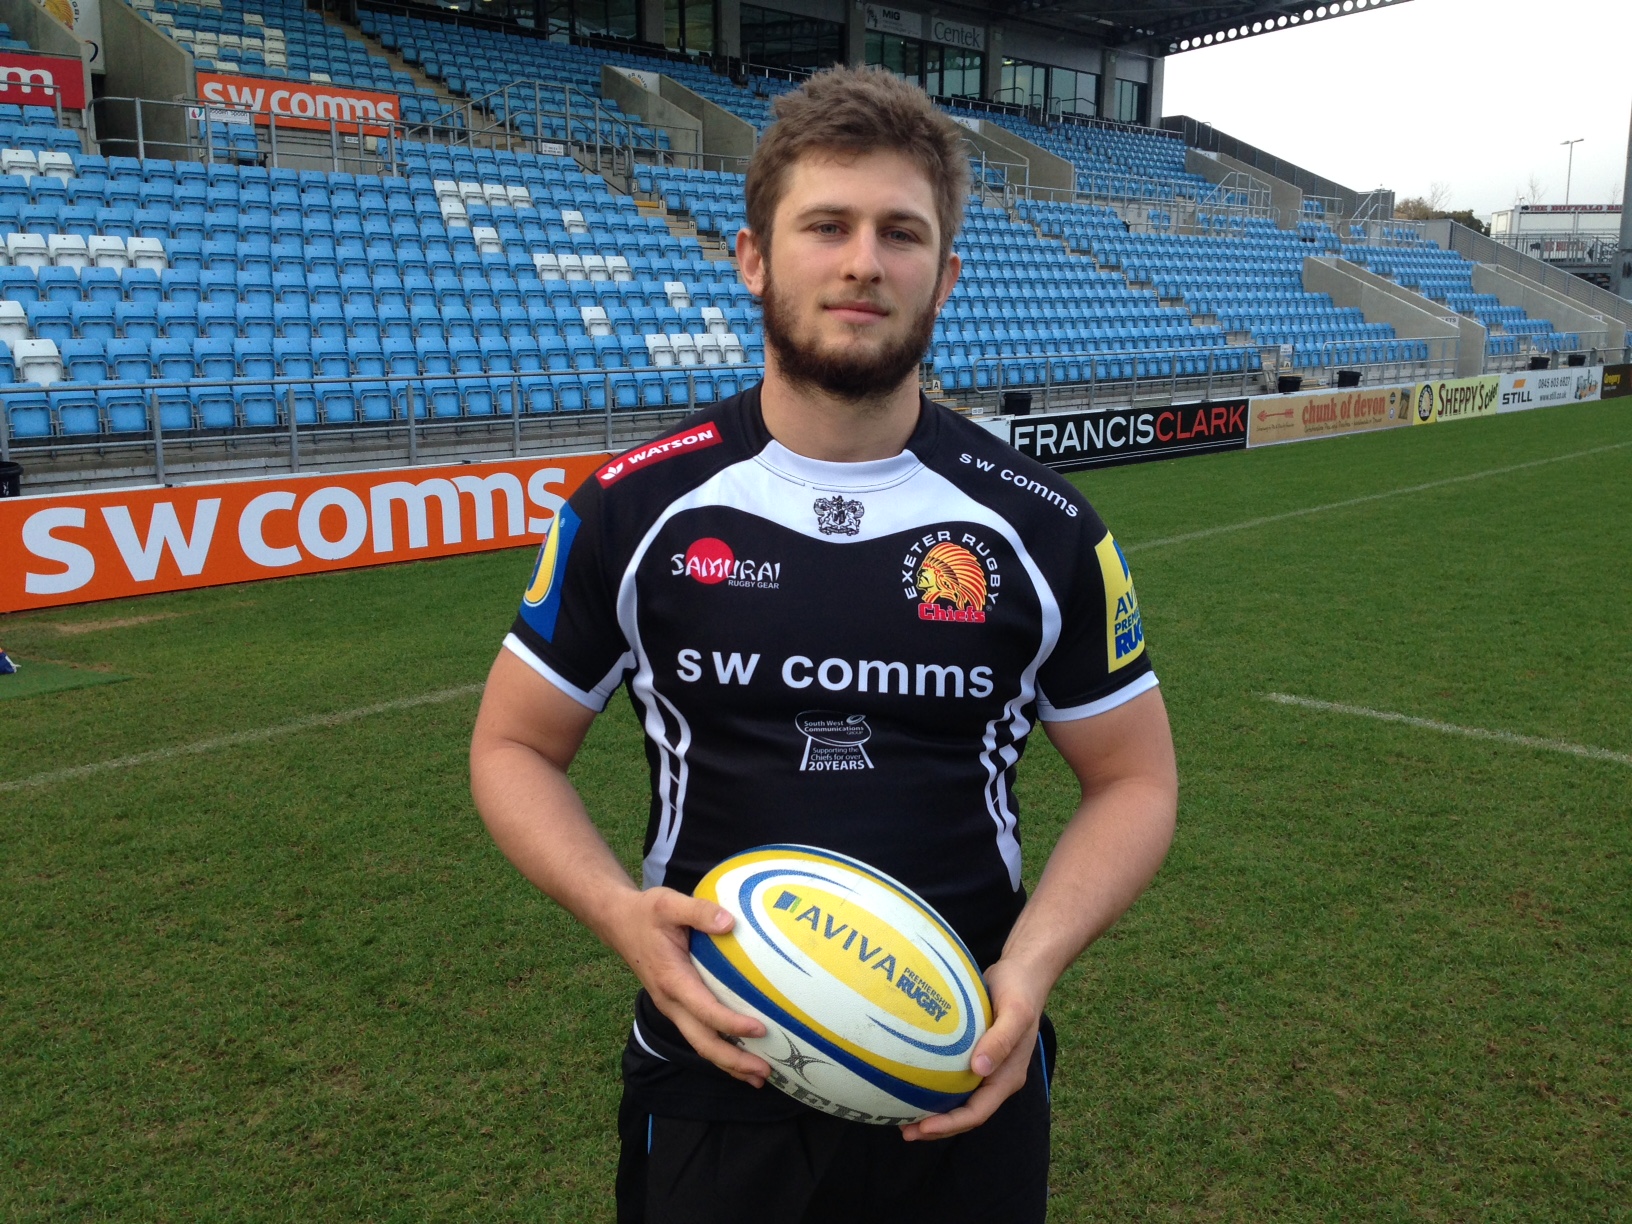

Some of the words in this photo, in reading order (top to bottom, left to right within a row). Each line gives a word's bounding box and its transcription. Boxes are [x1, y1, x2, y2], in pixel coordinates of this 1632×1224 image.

[934, 22, 980, 48] Centek
[270, 90, 395, 128] comms
[721, 242, 726, 250] G
[1302, 398, 1337, 425] chunk
[1340, 394, 1352, 421] of
[1354, 394, 1386, 418] devon
[1438, 383, 1484, 416] SHEPPY'S
[1502, 391, 1532, 405] STILL
[628, 430, 714, 464] WATSON
[1000, 469, 1078, 517] comms
[238, 467, 566, 567] comms
[671, 553, 780, 582] SAMURAI
[902, 530, 951, 600] EXETER
[961, 533, 1001, 604] RUGBY
[728, 580, 755, 588] RUGBY
[757, 581, 779, 589] GEAR
[918, 603, 986, 623] Chiefs
[782, 656, 994, 698] comms
[795, 905, 897, 982] AVIVA
[896, 974, 949, 1022] RUGBY
[903, 967, 952, 1011] PREMIERSHIP
